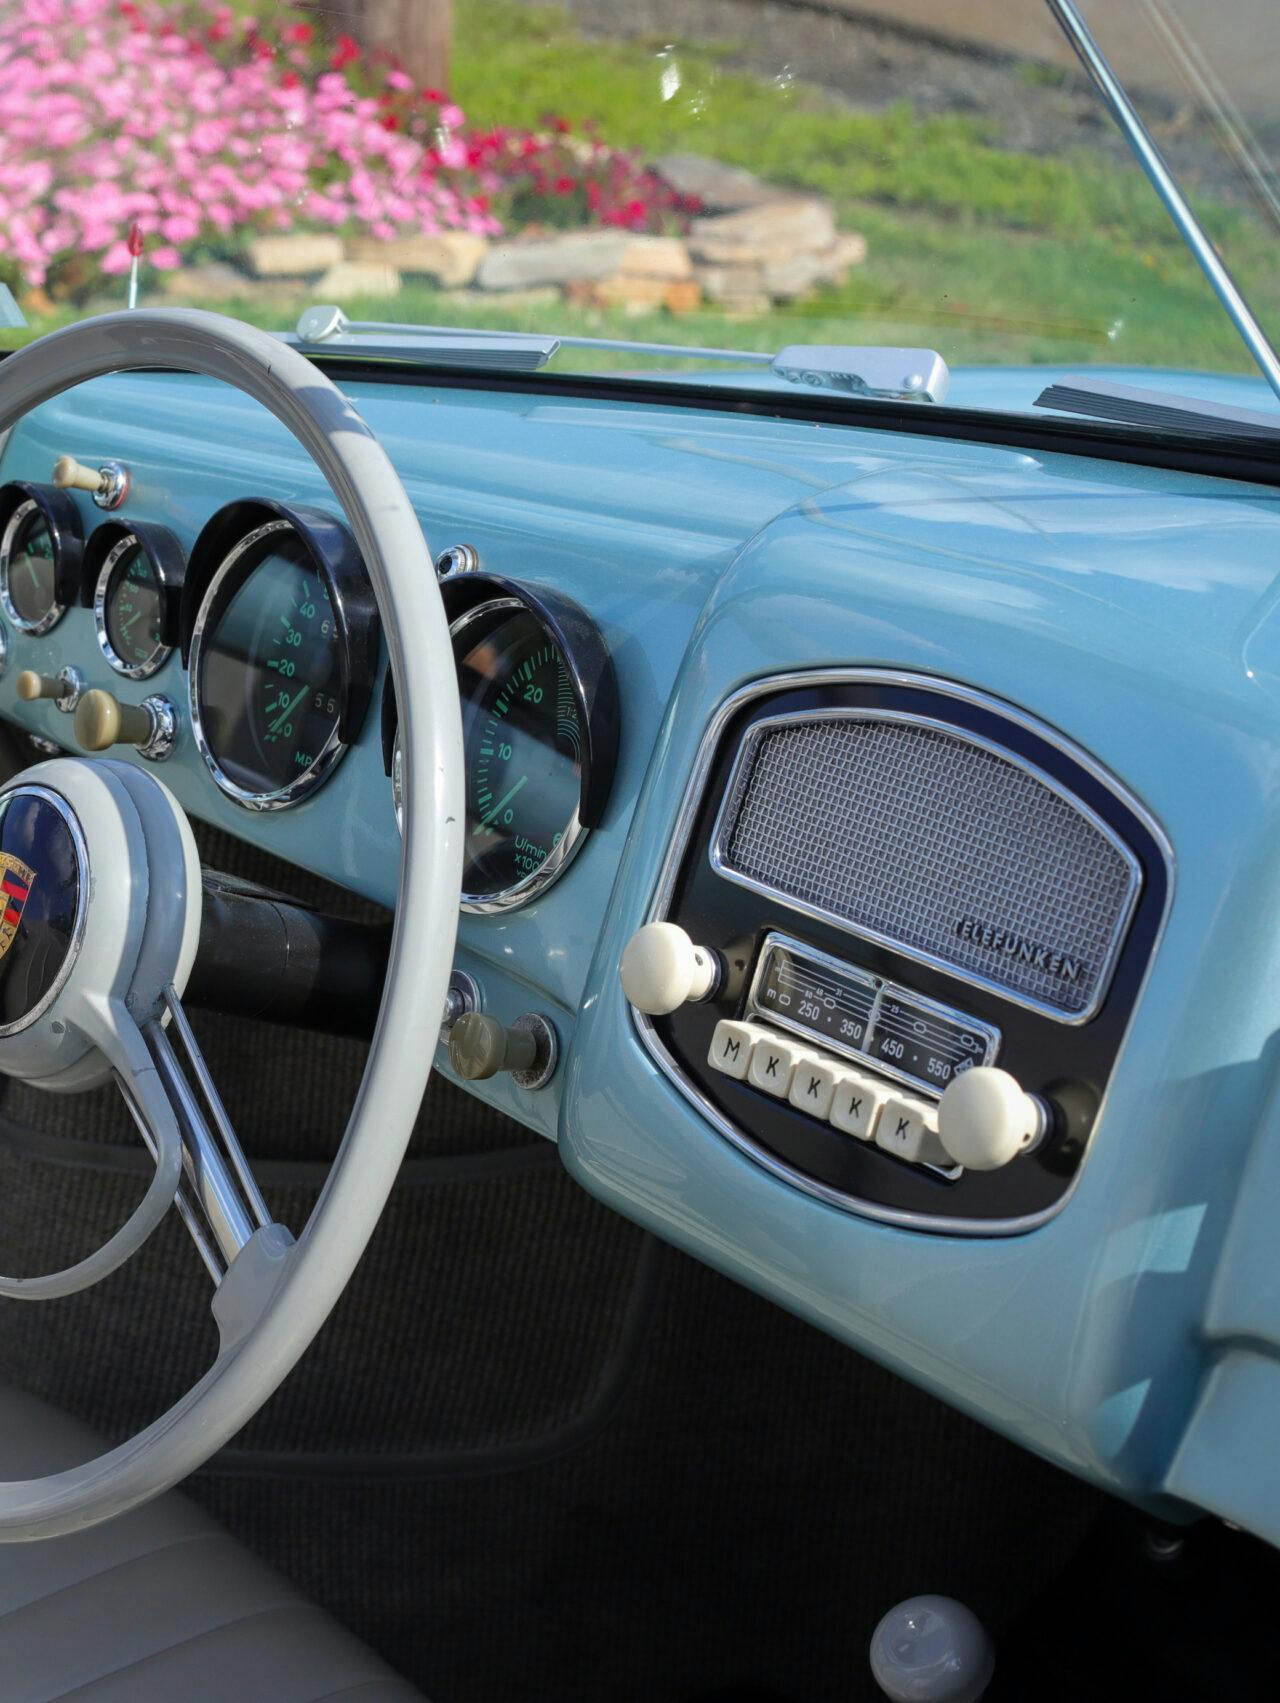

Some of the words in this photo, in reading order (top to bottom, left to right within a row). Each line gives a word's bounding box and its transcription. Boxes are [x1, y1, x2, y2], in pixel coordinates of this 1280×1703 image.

[300, 602, 315, 618] 40
[286, 629, 302, 646] 30
[279, 658, 295, 676] 20
[278, 691, 290, 708] 10
[523, 685, 543, 703] 20
[284, 723, 293, 737] 0
[498, 743, 512, 760] 10
[504, 808, 513, 823] 0
[952, 918, 1082, 980] TELEFUNKEN
[766, 988, 777, 1000] m
[798, 1000, 820, 1021] 250
[840, 1019, 862, 1040] 350
[881, 1038, 904, 1059] 450
[927, 1058, 951, 1080] 550
[723, 1037, 741, 1062] M
[766, 1056, 780, 1077] K
[807, 1076, 821, 1098] K
[849, 1097, 862, 1118] K
[895, 1117, 910, 1140] K
